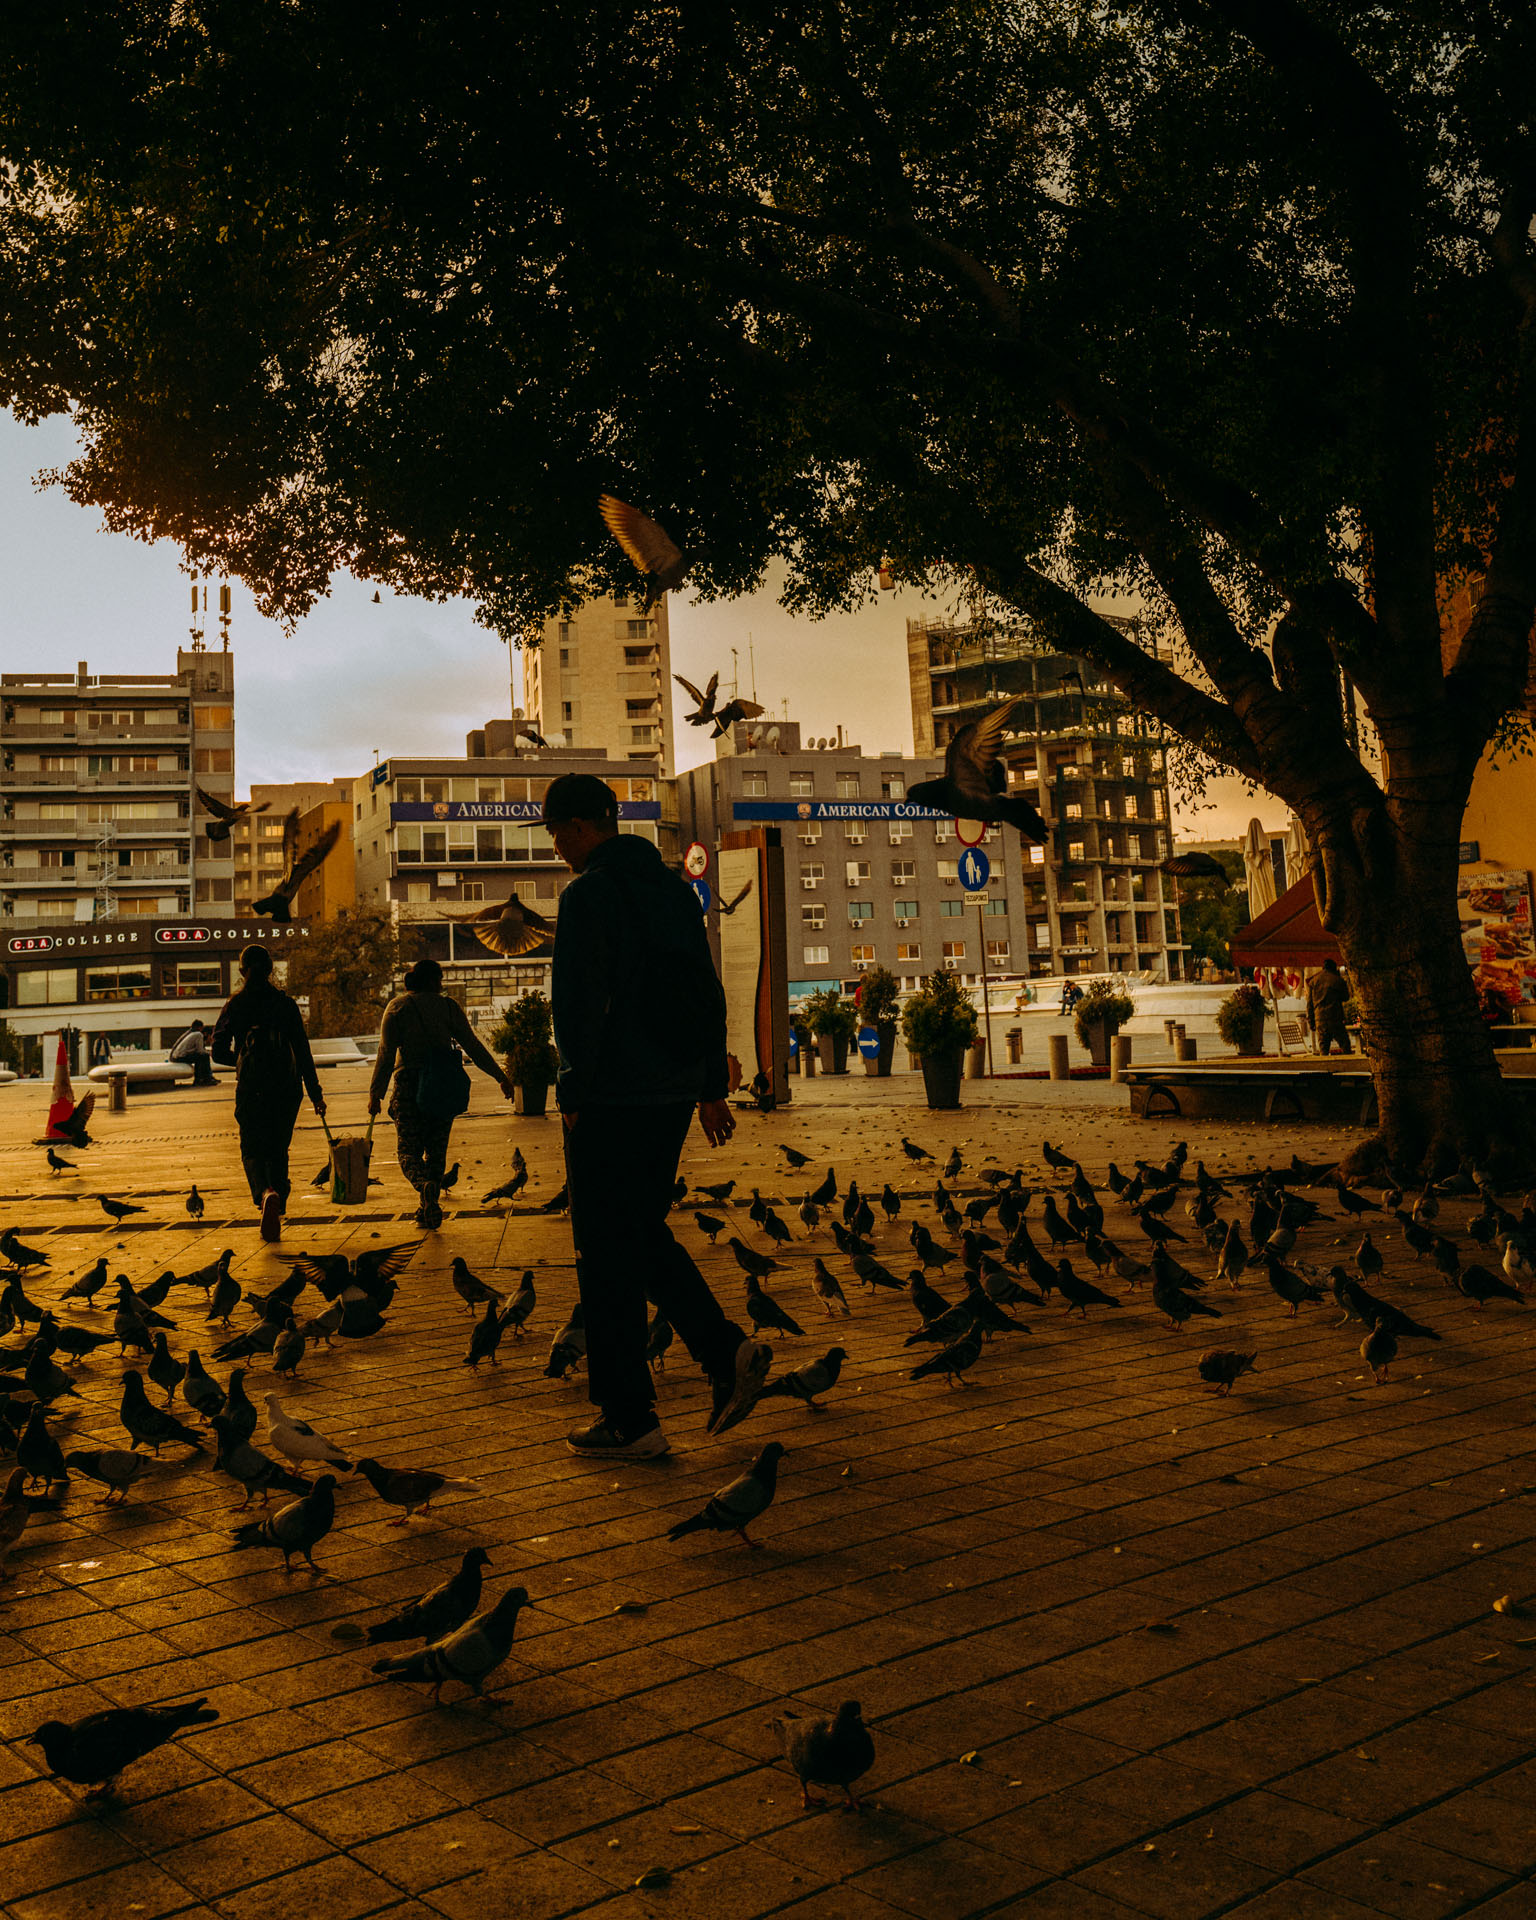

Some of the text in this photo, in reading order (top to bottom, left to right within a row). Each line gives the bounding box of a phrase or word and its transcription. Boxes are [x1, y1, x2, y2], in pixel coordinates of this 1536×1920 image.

[456, 802, 543, 817] AMERICAN
[817, 803, 890, 817] AMERICAN
[55, 932, 138, 947] COLLEGE
